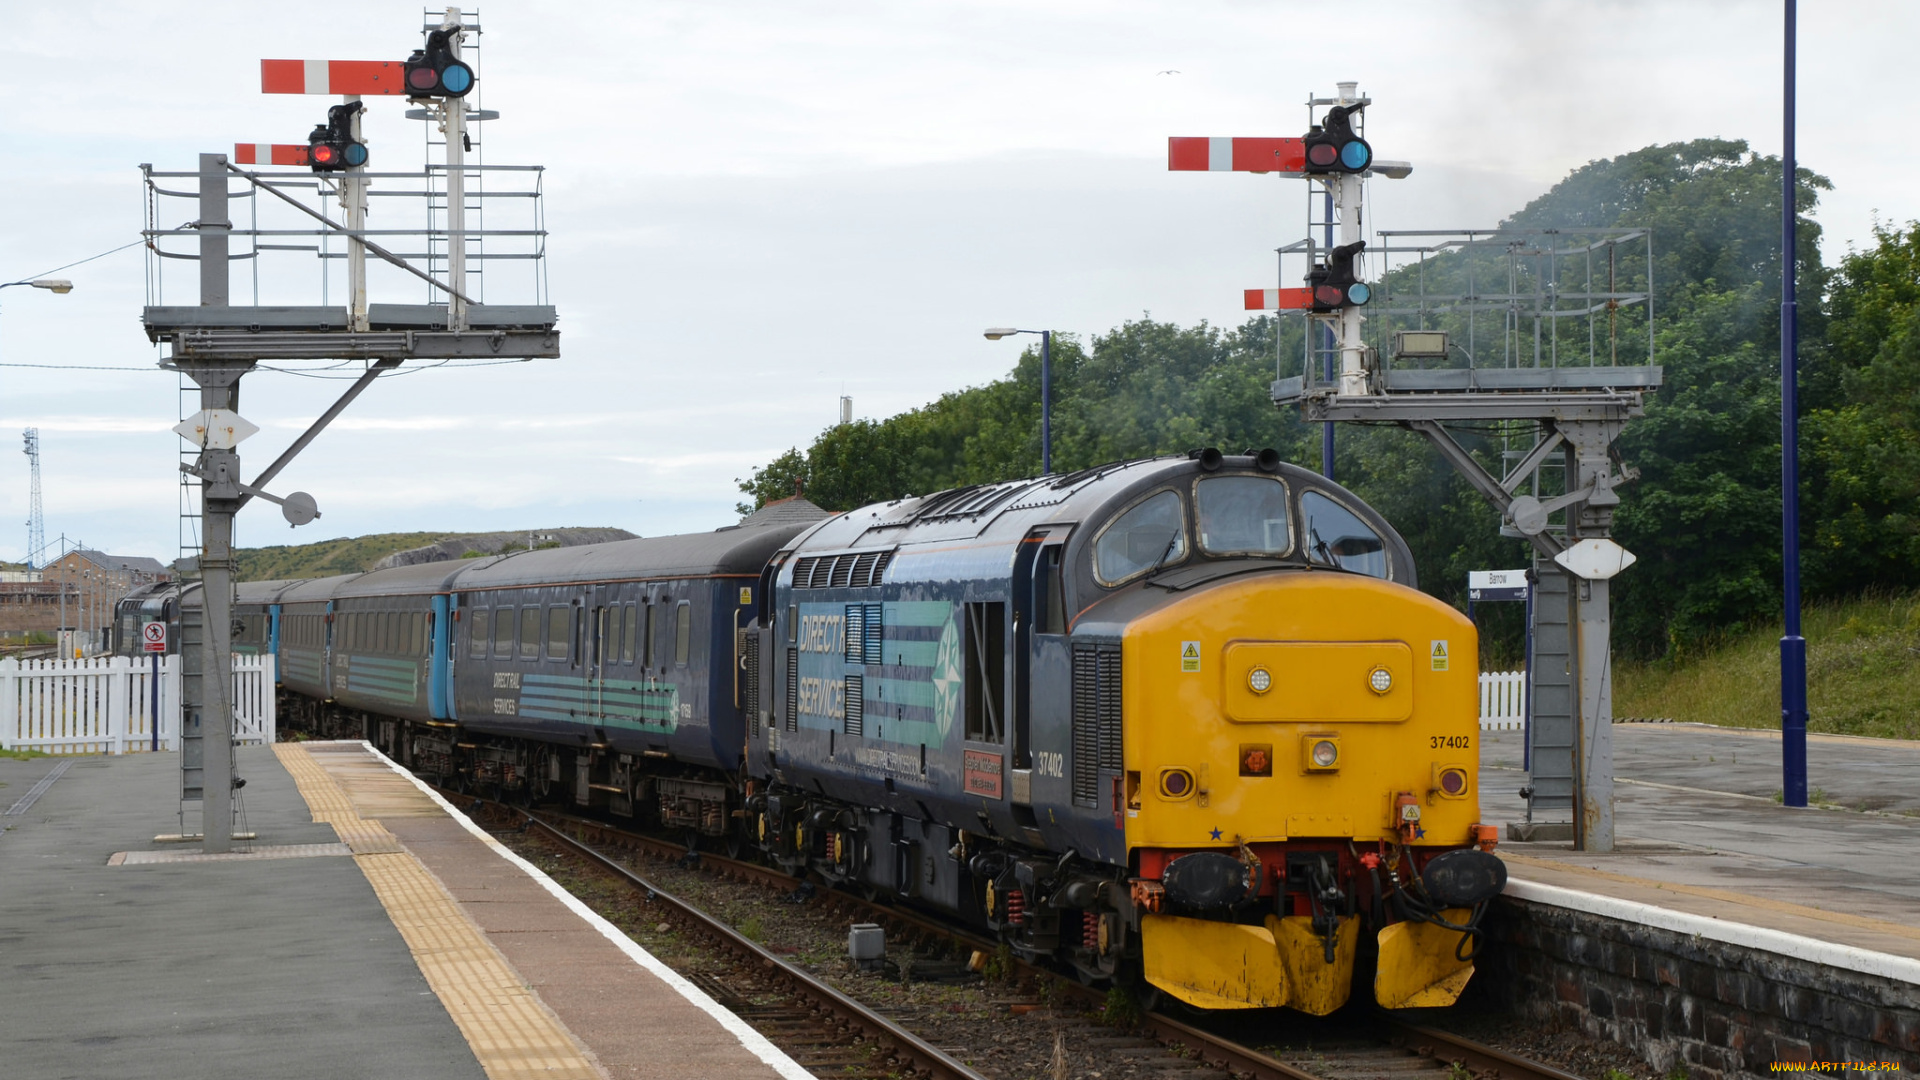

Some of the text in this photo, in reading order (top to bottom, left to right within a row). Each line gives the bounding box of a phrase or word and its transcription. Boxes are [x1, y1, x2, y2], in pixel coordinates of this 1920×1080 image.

[1489, 572, 1507, 585] Barrow
[800, 615, 839, 655] DIRECT
[494, 698, 515, 715] SERVICES
[798, 676, 850, 719] SERVICES
[1430, 736, 1469, 749] 37402
[1038, 751, 1063, 778] 37402
